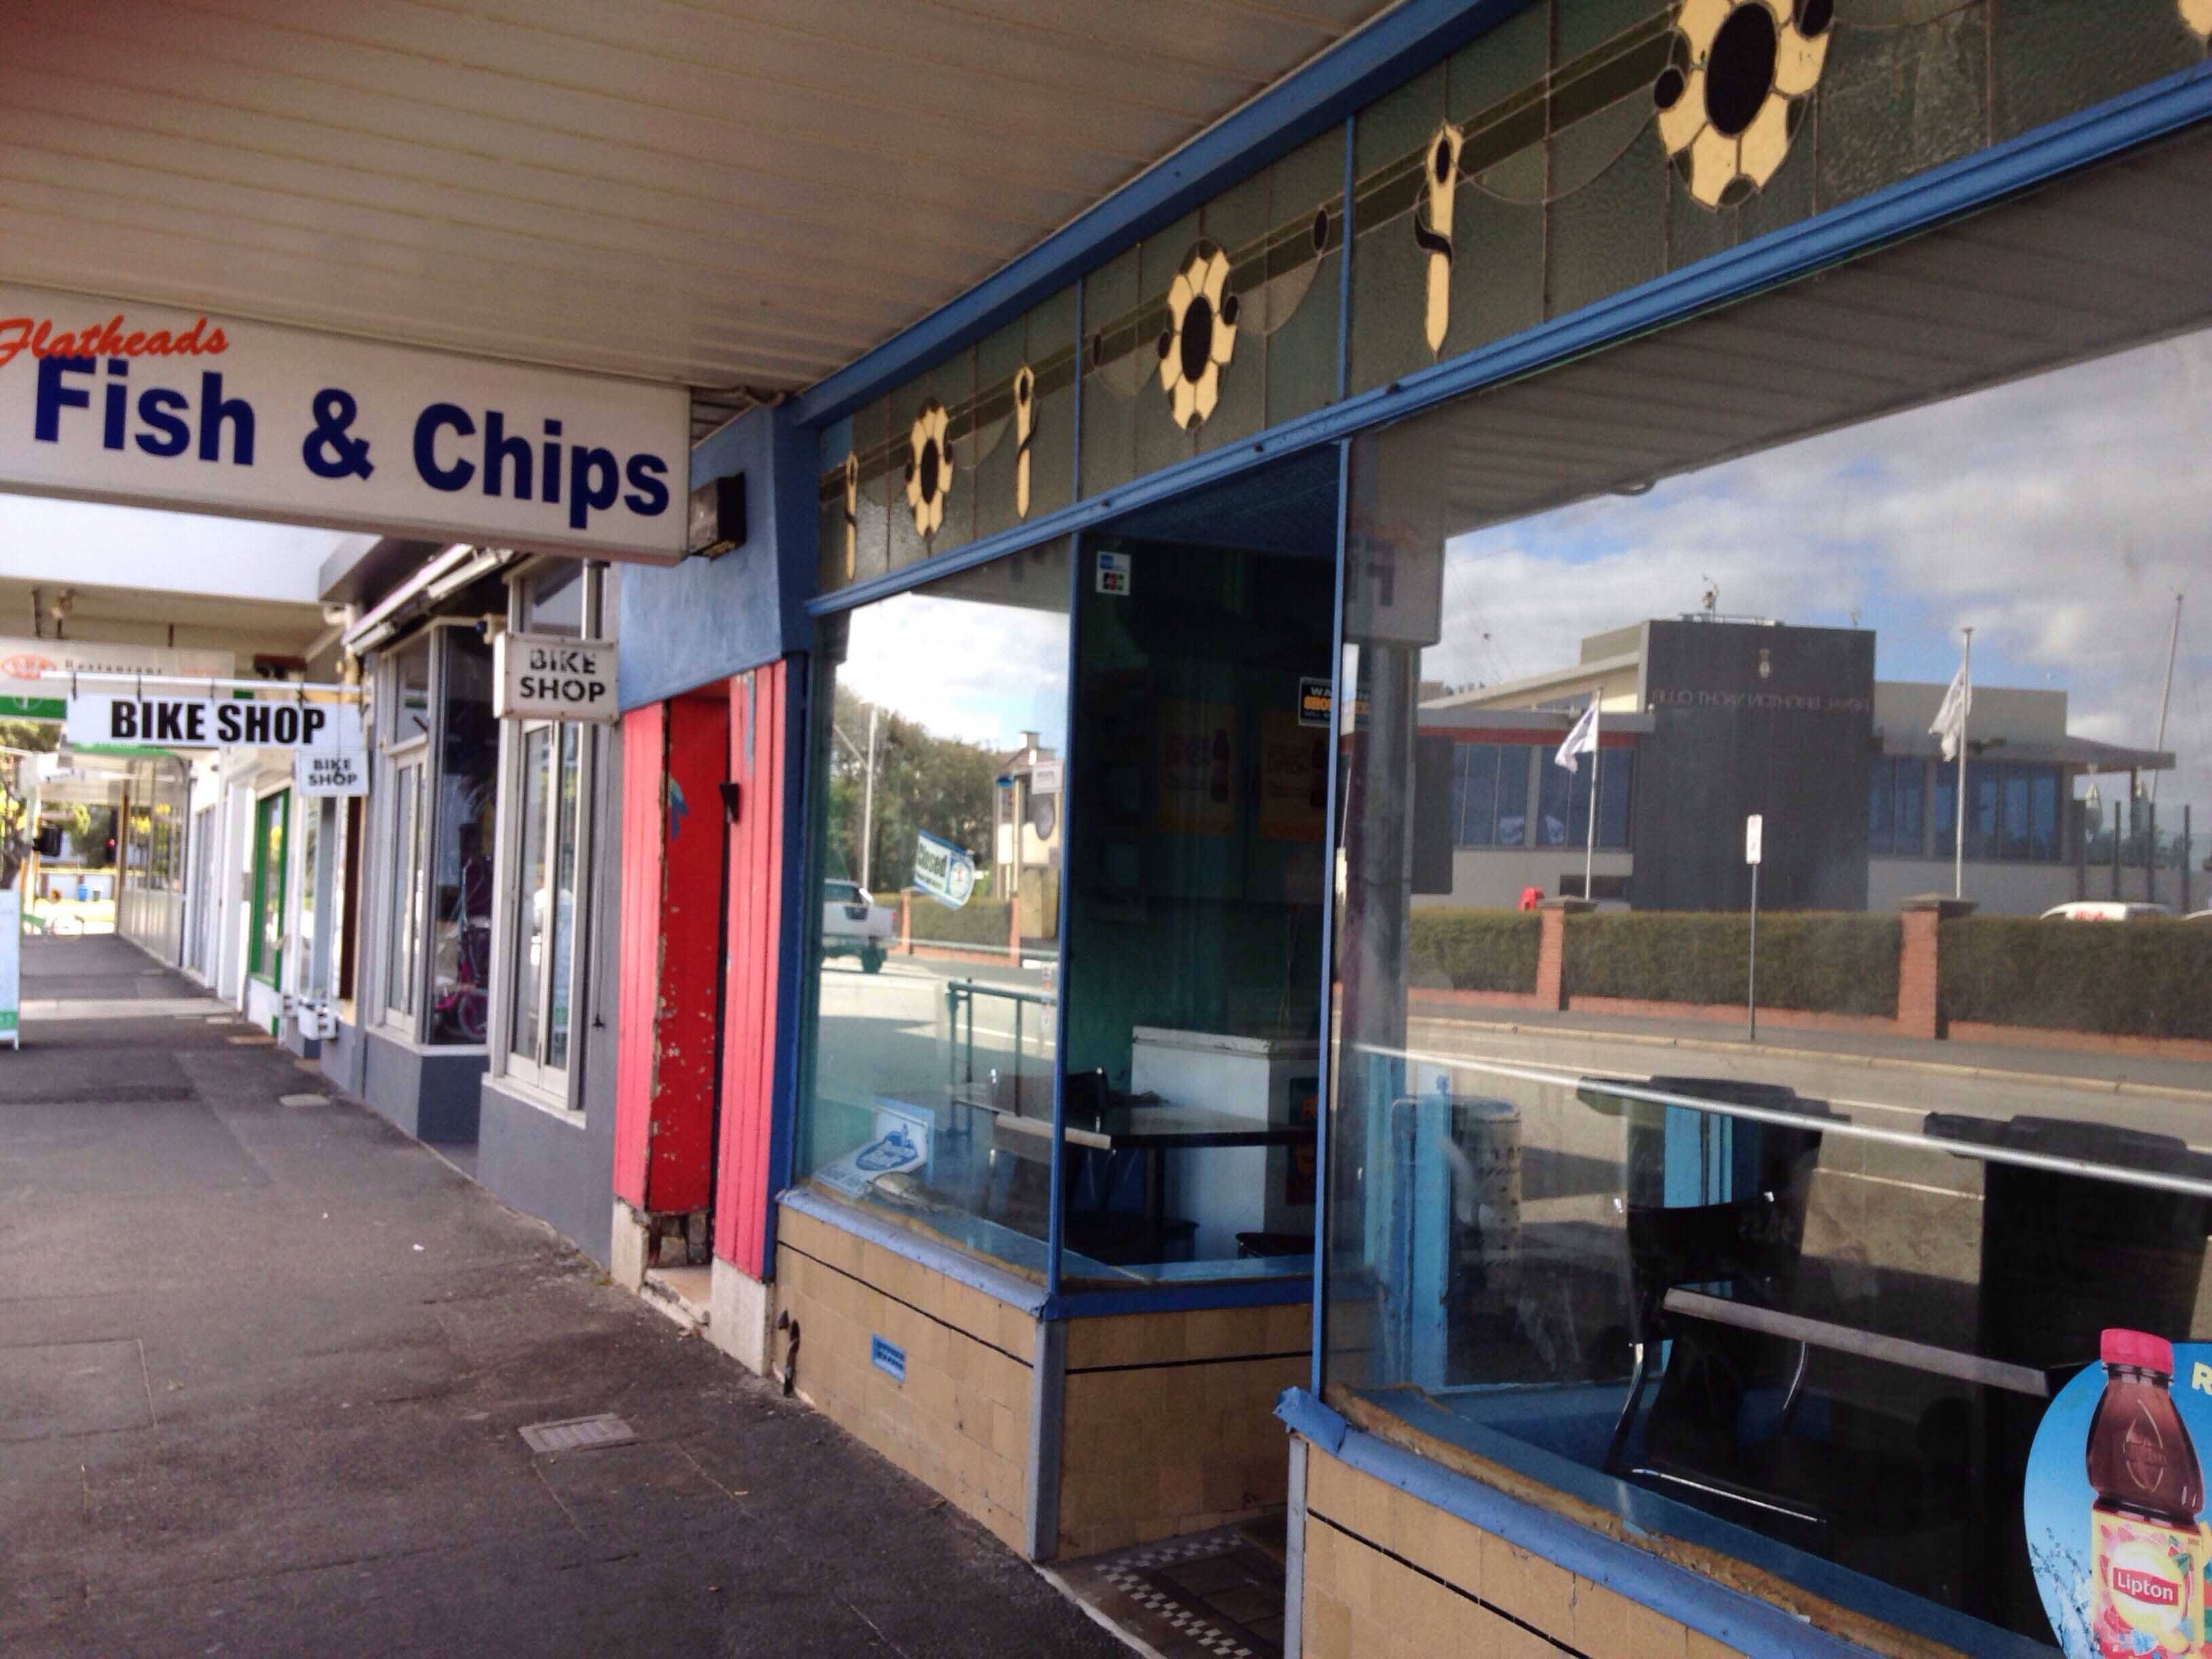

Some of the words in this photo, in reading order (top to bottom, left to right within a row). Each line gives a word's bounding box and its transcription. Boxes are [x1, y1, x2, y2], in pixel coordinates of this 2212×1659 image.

[0, 314, 229, 369] Flatheads
[33, 354, 255, 466] Fish
[302, 388, 374, 482] &
[413, 403, 670, 529] Chips
[531, 648, 596, 674] BIKE
[520, 676, 605, 702] SHOP
[111, 701, 206, 741] BIKE
[217, 703, 325, 744] SHOP
[314, 758, 351, 771] BIKE
[308, 772, 357, 786] SHOP
[2117, 1572, 2174, 1601] Lipton
